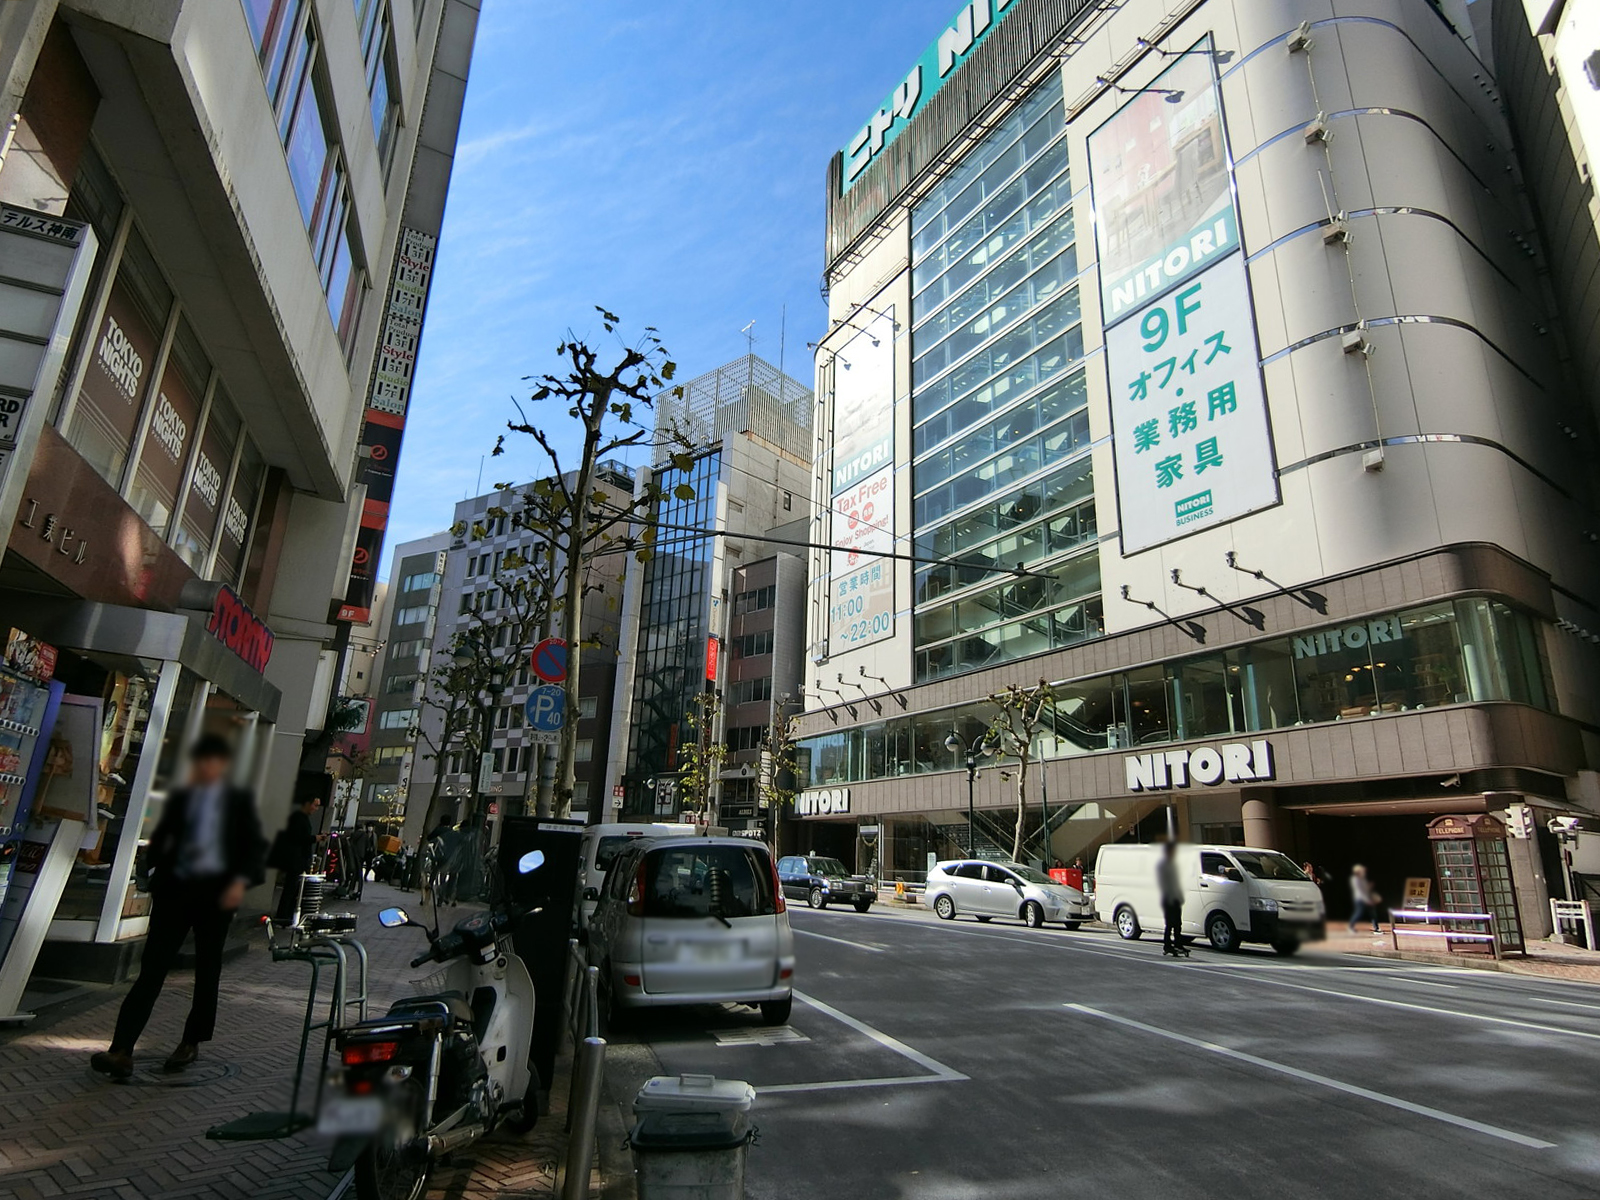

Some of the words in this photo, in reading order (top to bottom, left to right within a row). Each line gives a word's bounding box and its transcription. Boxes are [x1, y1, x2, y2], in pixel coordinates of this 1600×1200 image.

[849, 65, 921, 182] ニトリ
[938, 0, 1016, 78] NI
[4, 212, 79, 240] テルス神南
[400, 255, 429, 272] Style
[412, 250, 424, 259] 3F
[1111, 218, 1228, 313] NITORI
[395, 280, 425, 296] Studio
[405, 274, 419, 283] 3F
[391, 302, 421, 318] Salon
[402, 297, 414, 307] 7F
[1140, 282, 1202, 353] 9F
[107, 316, 143, 378] TOKYO
[382, 345, 413, 361] Style
[395, 338, 408, 348] 3F
[98, 358, 115, 382] PHOTO
[99, 336, 138, 398] NIGHTS
[377, 372, 409, 387] Studio
[388, 364, 401, 373] 3F
[1128, 330, 1232, 402] オフィス
[372, 395, 404, 411] Salon
[384, 389, 397, 398] 7F
[158, 392, 186, 441] TOKYO
[1133, 380, 1238, 455] 業務用
[152, 410, 182, 459] NIGHTS
[199, 451, 221, 491] TOKYO
[836, 439, 889, 488] NITORI
[1155, 436, 1223, 489] 家具
[194, 467, 217, 506] NIGHTS
[837, 494, 857, 513] Tax
[858, 476, 888, 503] Free
[230, 496, 248, 530] TOKYO
[1176, 507, 1214, 526] BUSINESS
[1177, 494, 1210, 514] NITORI
[24, 499, 87, 565] 工業ビル
[839, 564, 881, 597] 営業時間
[341, 609, 355, 618] 9F
[831, 595, 863, 623] 11:00
[1293, 616, 1403, 659] NITORI
[542, 688, 561, 697] 7-20
[534, 695, 555, 723] P
[547, 712, 560, 725] 40
[1125, 740, 1272, 790] NITORI
[795, 789, 849, 814] NITORI
